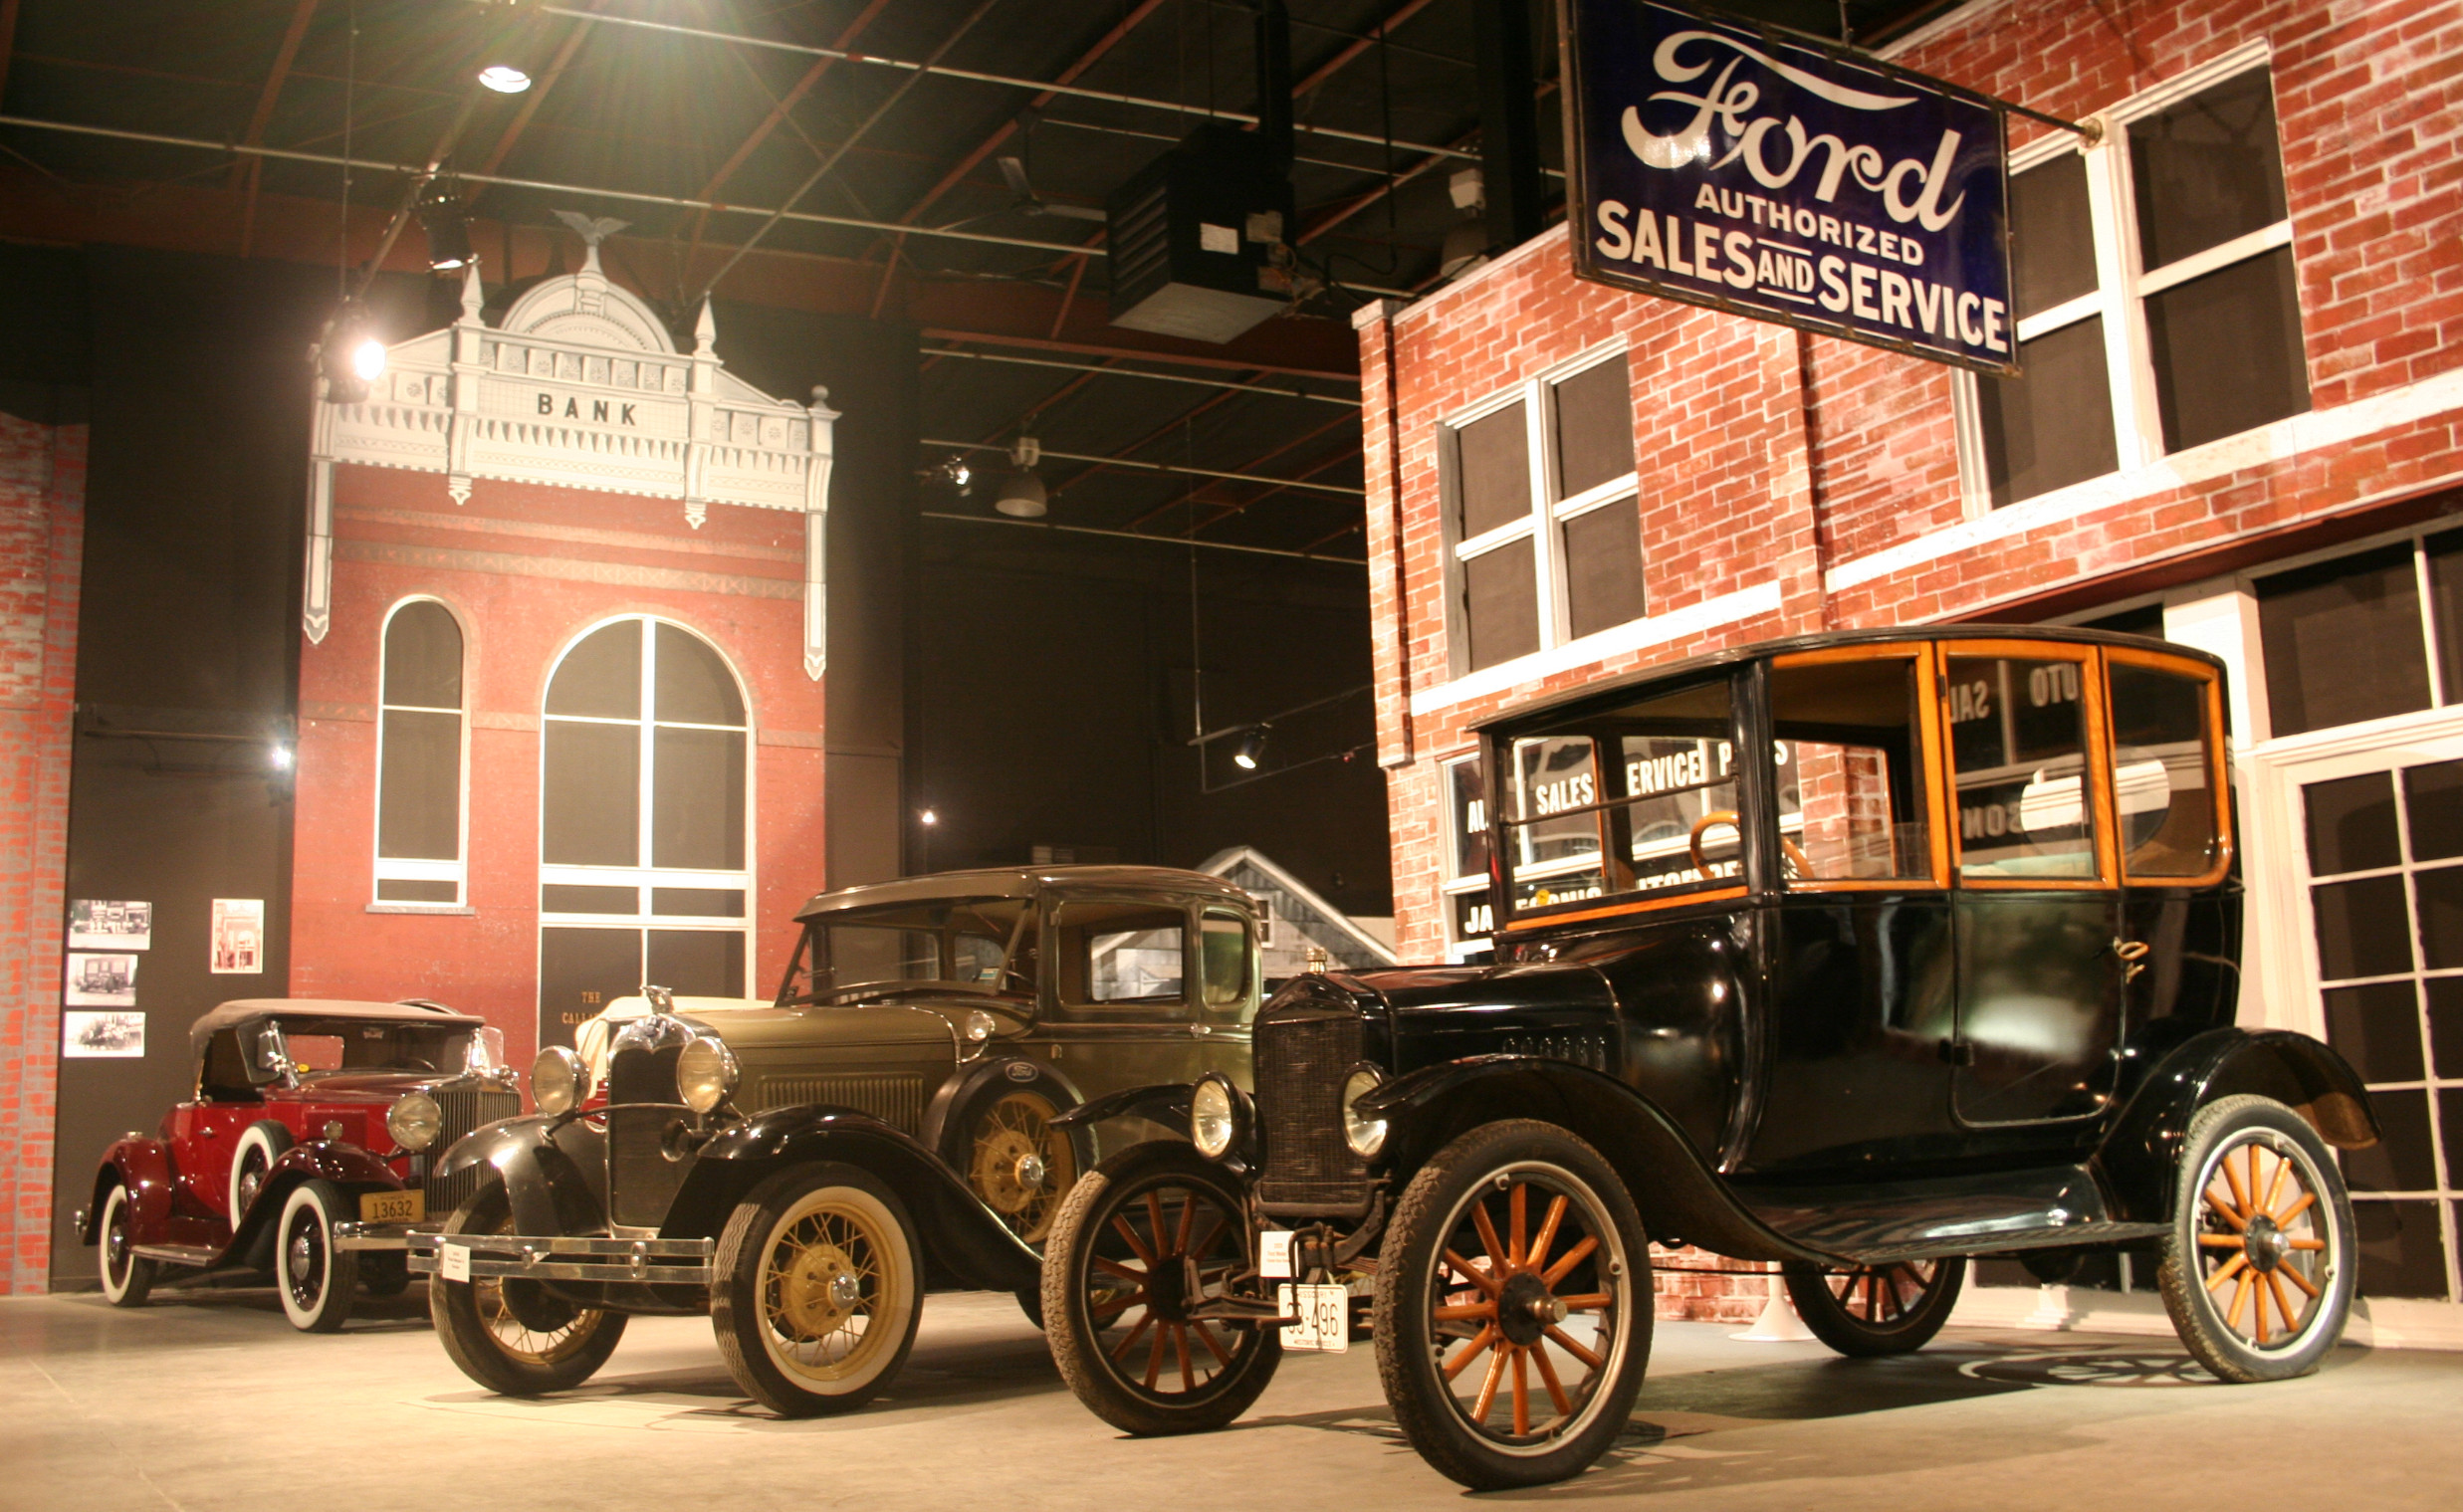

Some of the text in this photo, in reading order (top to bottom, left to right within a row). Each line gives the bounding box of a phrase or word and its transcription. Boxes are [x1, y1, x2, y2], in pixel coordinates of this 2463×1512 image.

[1622, 30, 1965, 232] Ford
[1694, 183, 1923, 266] AUTHORIZED
[1596, 200, 2007, 353] SALES AND SERVICE
[538, 393, 636, 426] BANK
[1536, 772, 1594, 815] SALES
[1627, 750, 1701, 796] ERVICE
[581, 991, 601, 1003] THE
[372, 1199, 413, 1219] 13632
